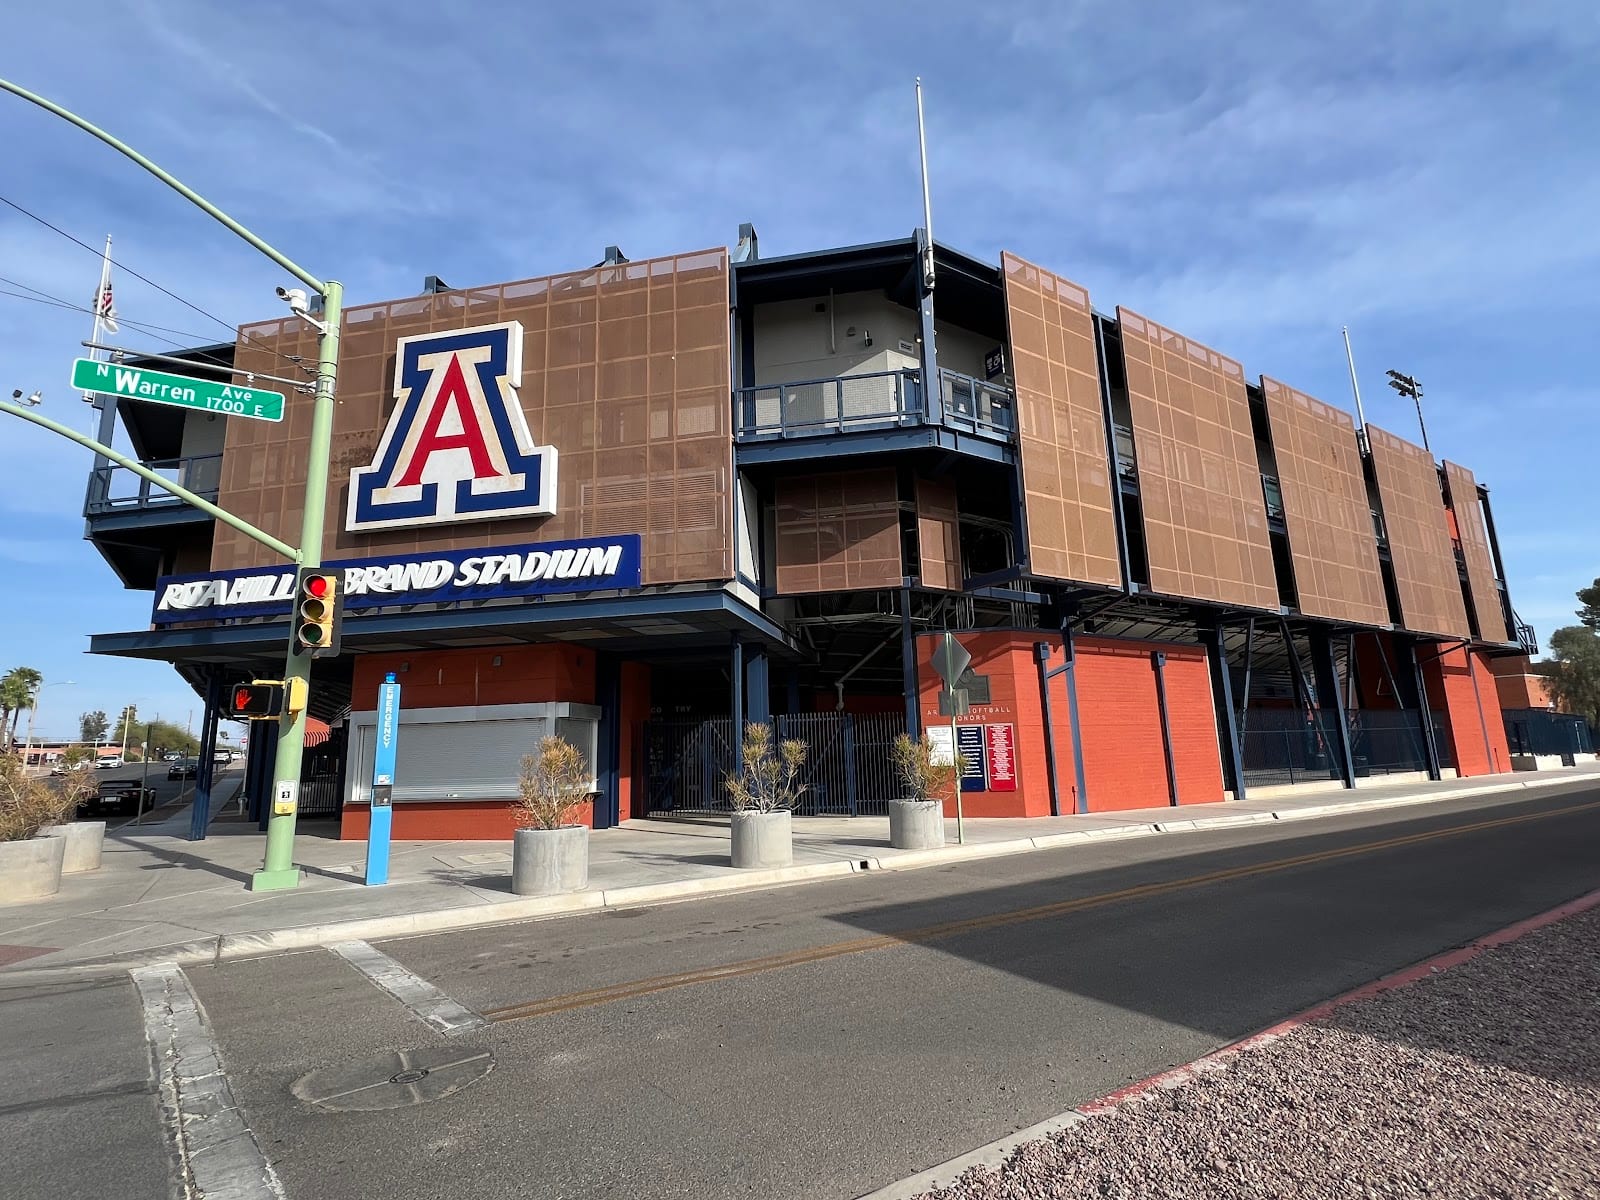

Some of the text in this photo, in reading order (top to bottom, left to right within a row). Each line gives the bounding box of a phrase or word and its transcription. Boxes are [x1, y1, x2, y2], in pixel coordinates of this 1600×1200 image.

[96, 365, 253, 402] N Warren Ave
[206, 397, 264, 417] 1700 E
[347, 321, 557, 531] A
[157, 545, 622, 610] RITA HILLBRAND STADIUM
[383, 686, 394, 748] EMERGENCY
